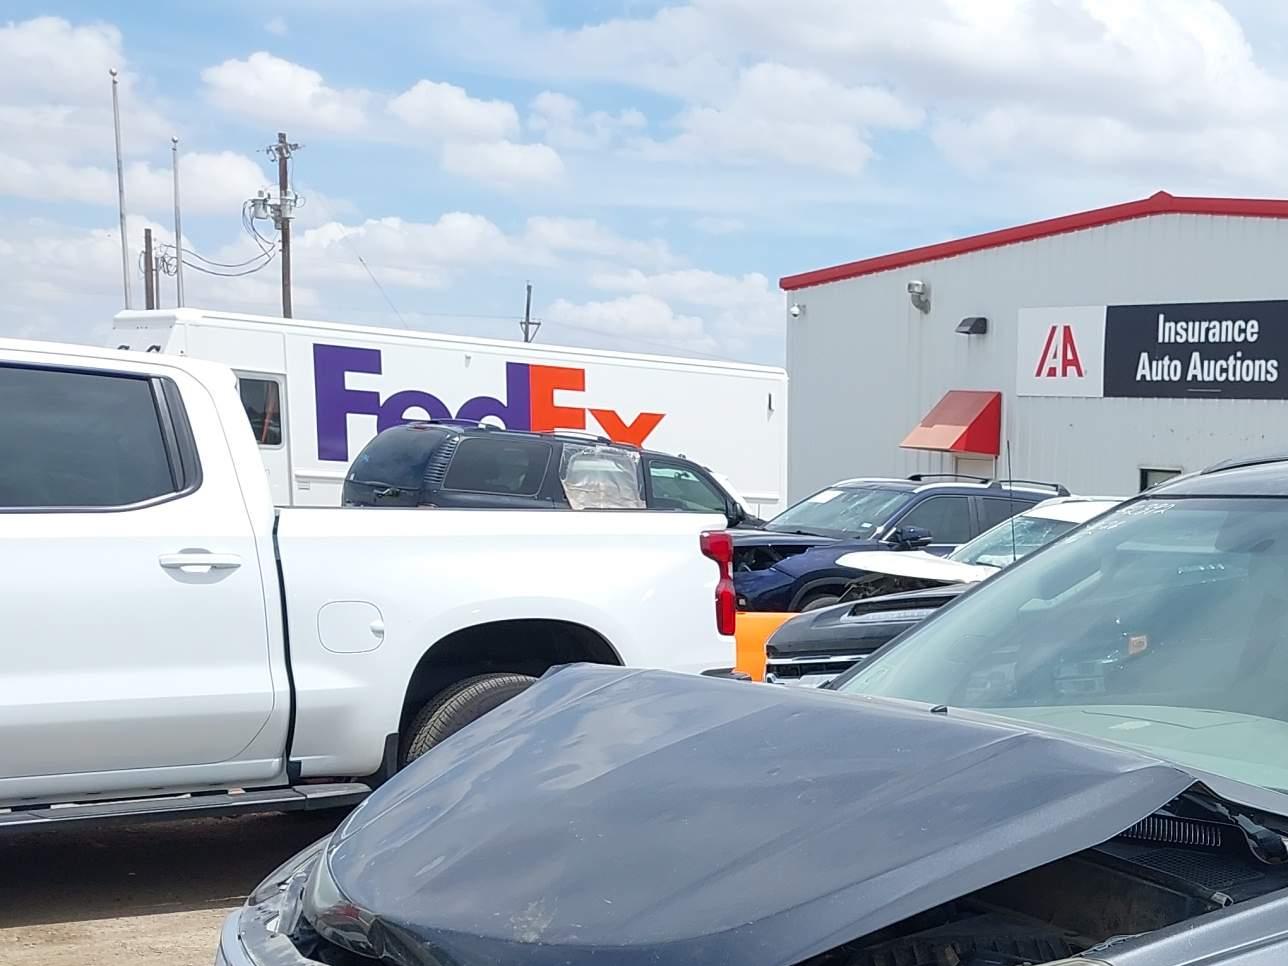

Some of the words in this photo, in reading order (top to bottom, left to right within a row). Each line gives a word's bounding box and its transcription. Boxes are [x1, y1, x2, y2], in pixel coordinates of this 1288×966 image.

[1157, 313, 1259, 344] Insurance
[1135, 352, 1181, 382] Auto
[1187, 351, 1279, 383] Auctions
